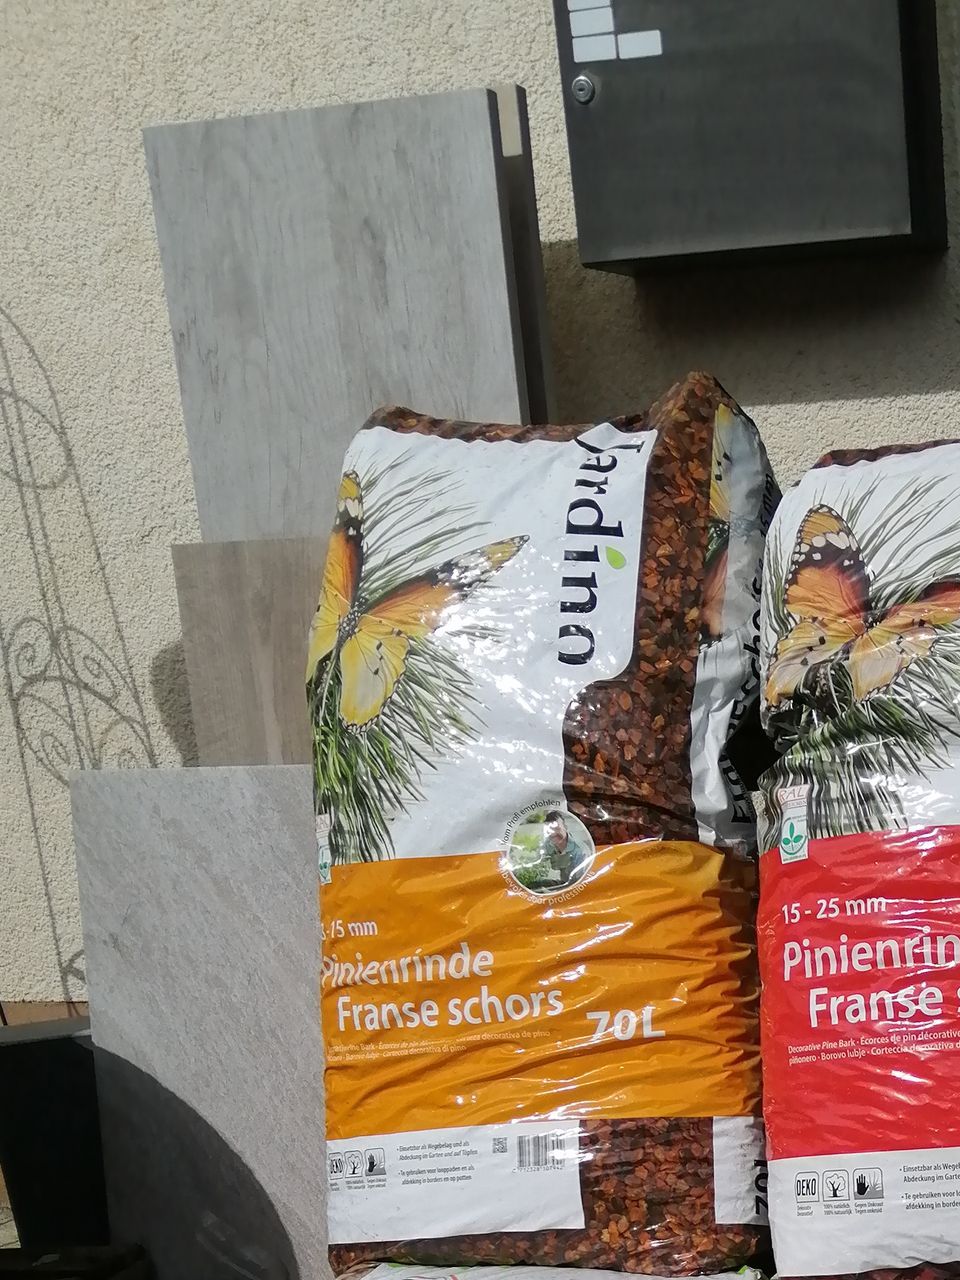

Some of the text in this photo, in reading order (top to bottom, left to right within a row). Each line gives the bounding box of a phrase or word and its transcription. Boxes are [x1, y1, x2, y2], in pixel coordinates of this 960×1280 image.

[558, 437, 645, 665] Jardino
[779, 787, 804, 803] RAL
[520, 799, 561, 816] empfohlen
[782, 897, 887, 924] 15 25 mm
[348, 921, 378, 937] mm
[321, 942, 494, 988] Pinienrinde
[338, 985, 565, 1032] Franse schors
[810, 984, 943, 1028] Franse
[586, 1006, 666, 1043] 70L
[821, 1040, 838, 1050] Pine
[838, 1038, 855, 1048] Bark
[796, 1178, 816, 1196] DEKO
[942, 1190, 955, 1198] voor
[905, 1201, 935, 1211] afdekking
